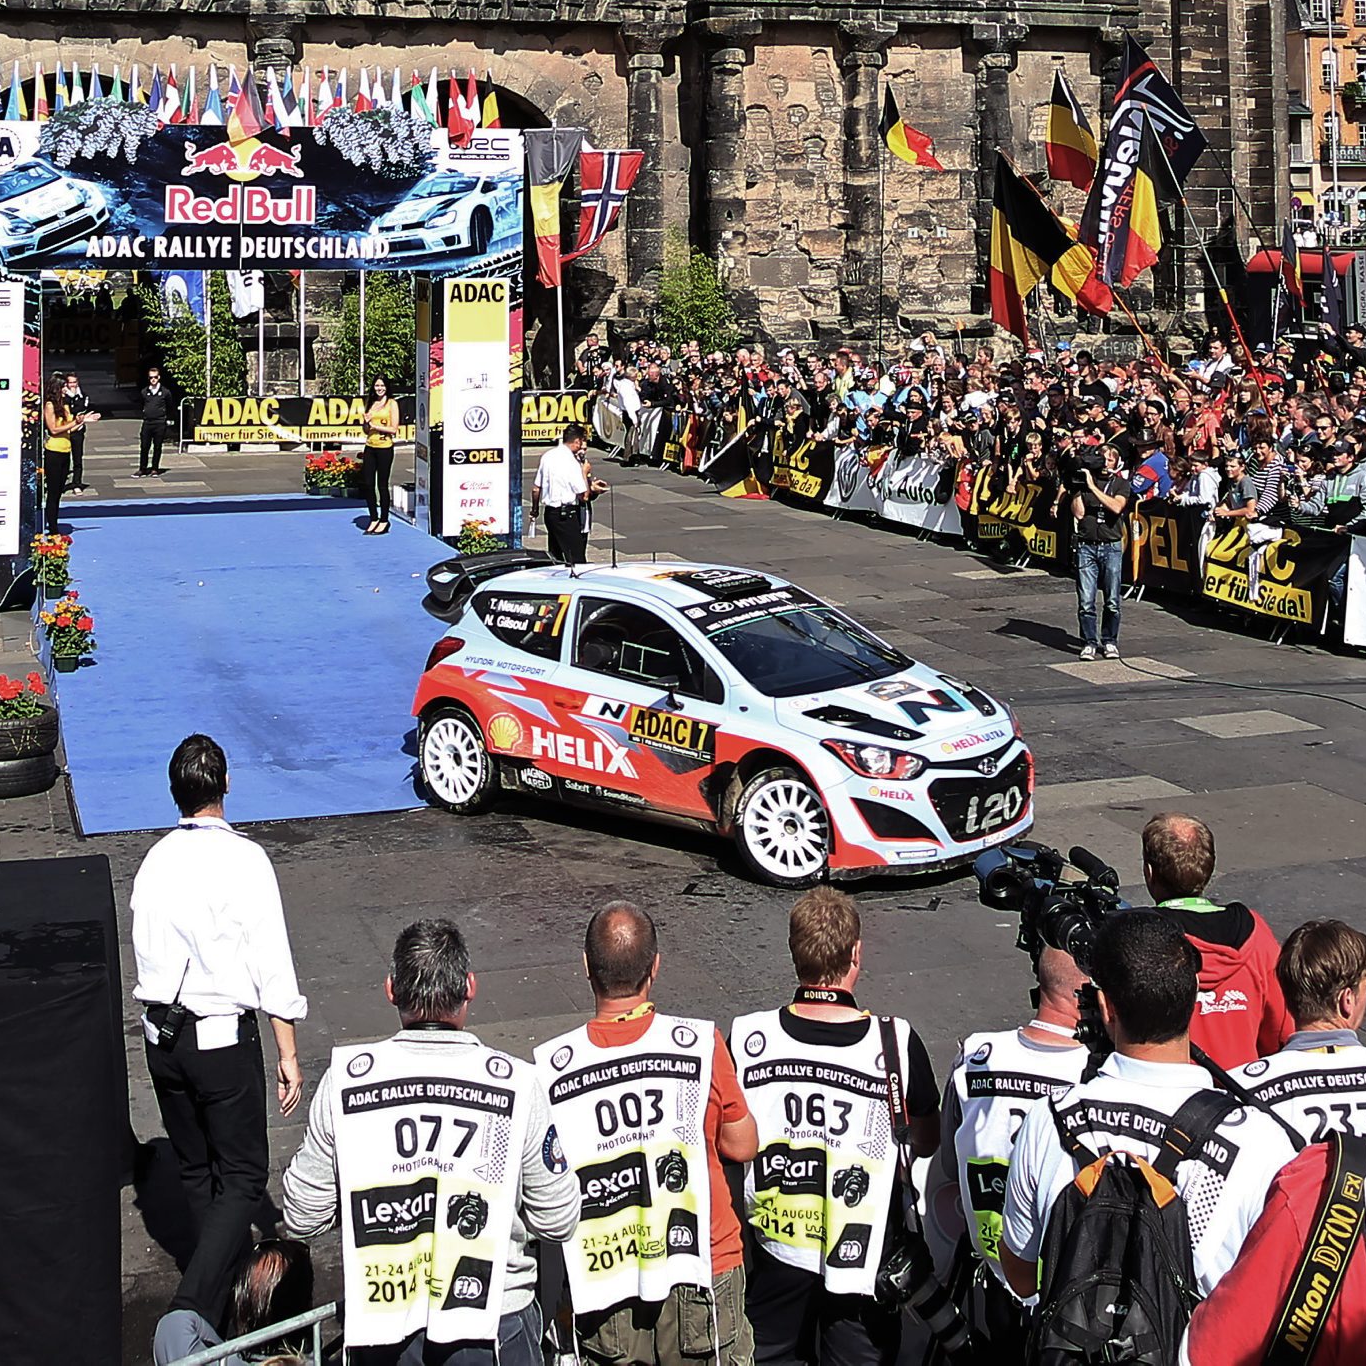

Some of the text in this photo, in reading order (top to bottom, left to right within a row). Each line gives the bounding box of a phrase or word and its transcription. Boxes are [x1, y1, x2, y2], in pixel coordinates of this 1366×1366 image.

[168, 187, 313, 222] Red Bull
[85, 236, 390, 259] ADAC RALLYE DEUTSCHLAND
[450, 283, 504, 303] ADAC
[201, 398, 367, 426] ADAC ADA
[199, 429, 235, 441] immer
[238, 429, 255, 441] für
[522, 429, 551, 440] mmer
[469, 451, 501, 462] OPEL
[497, 599, 535, 616] Neuville
[551, 594, 571, 637] 7
[1278, 590, 1306, 619] da!
[497, 616, 529, 632] Gilsoul
[497, 661, 546, 677] MOTORSPORT
[633, 709, 709, 750] ADAC 7
[952, 730, 1007, 751] HELIX ULTRA
[531, 726, 639, 779] HELIX
[565, 780, 591, 794] Sabelt
[603, 789, 646, 805] SoundHound
[880, 788, 915, 802] HELIX
[804, 991, 837, 1002] Canon
[554, 1058, 697, 1098] ADAC RALLYE DEUTSCHLAND
[747, 1067, 773, 1083] ADAC
[775, 1064, 813, 1077] RALLYE
[971, 1078, 993, 1090] ADAC
[995, 1077, 1031, 1093] RALLYE
[349, 1083, 509, 1109] ADAC RALLYE DEUTSCHLAND
[888, 1072, 901, 1114] Canon
[1255, 1083, 1283, 1103] DAC
[1284, 1075, 1325, 1092] RALLYE
[595, 1089, 664, 1137] 003
[784, 1092, 853, 1136] 063
[1087, 1108, 1130, 1127] ALLYE
[395, 1114, 478, 1159] 077
[1344, 1176, 1362, 1199] FX
[361, 1190, 435, 1225] Lexar
[760, 1215, 796, 1237] 014
[583, 1233, 618, 1249] 21-24
[587, 1239, 639, 1272] 2014
[365, 1264, 403, 1277] 21-24
[1285, 1203, 1359, 1353] Nikon D700
[368, 1274, 417, 1302] 2014
